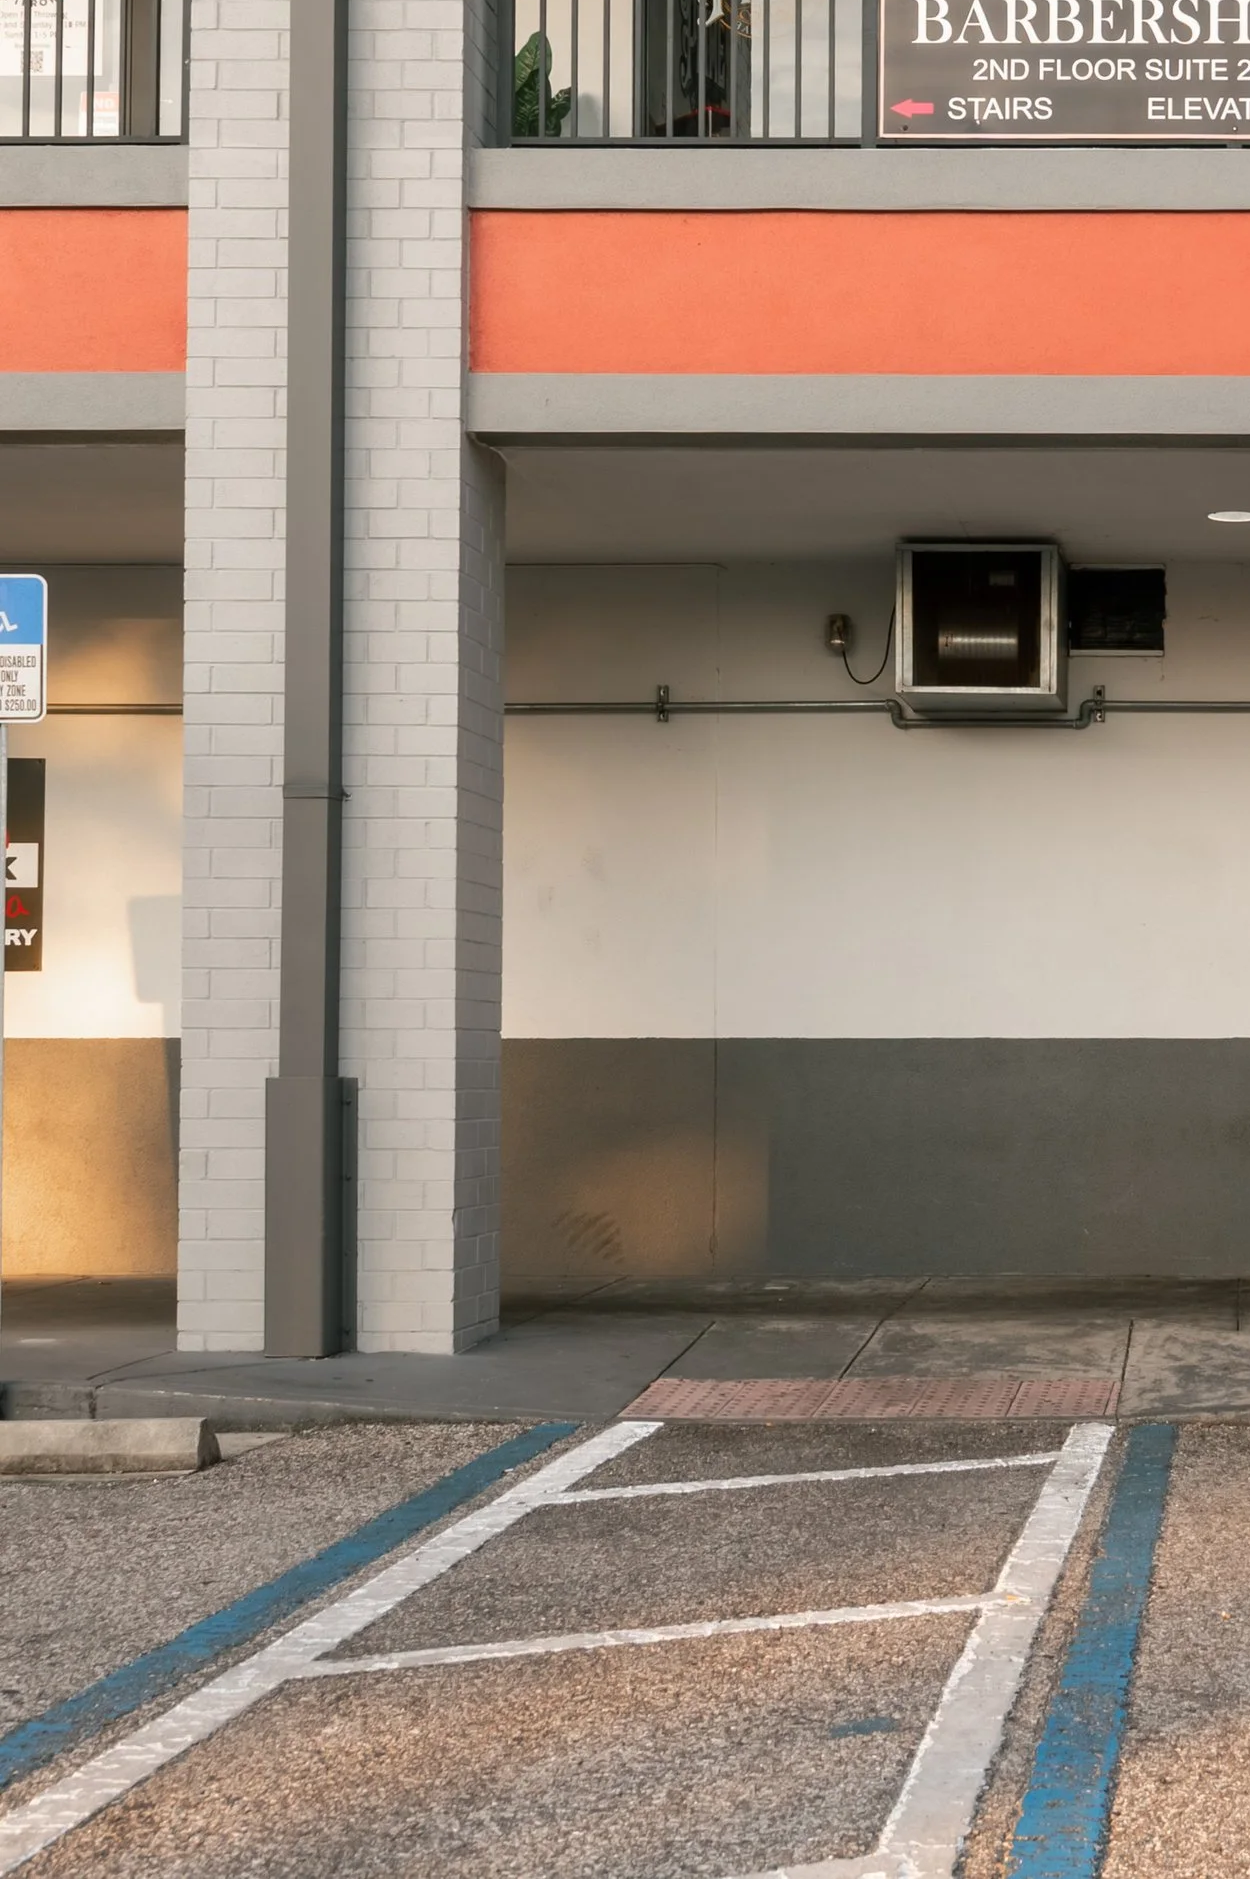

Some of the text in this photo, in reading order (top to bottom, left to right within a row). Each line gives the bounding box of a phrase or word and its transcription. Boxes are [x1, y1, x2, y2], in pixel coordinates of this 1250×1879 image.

[973, 59, 1029, 81] 2ND
[1039, 59, 1137, 81] FLOOR
[1145, 59, 1229, 81] SUITE
[948, 97, 1053, 120] STAIRS
[0, 655, 37, 668] DISABLED
[1, 669, 19, 682] ONLY
[6, 684, 26, 697] ZONE
[5, 699, 37, 712] $250.00
